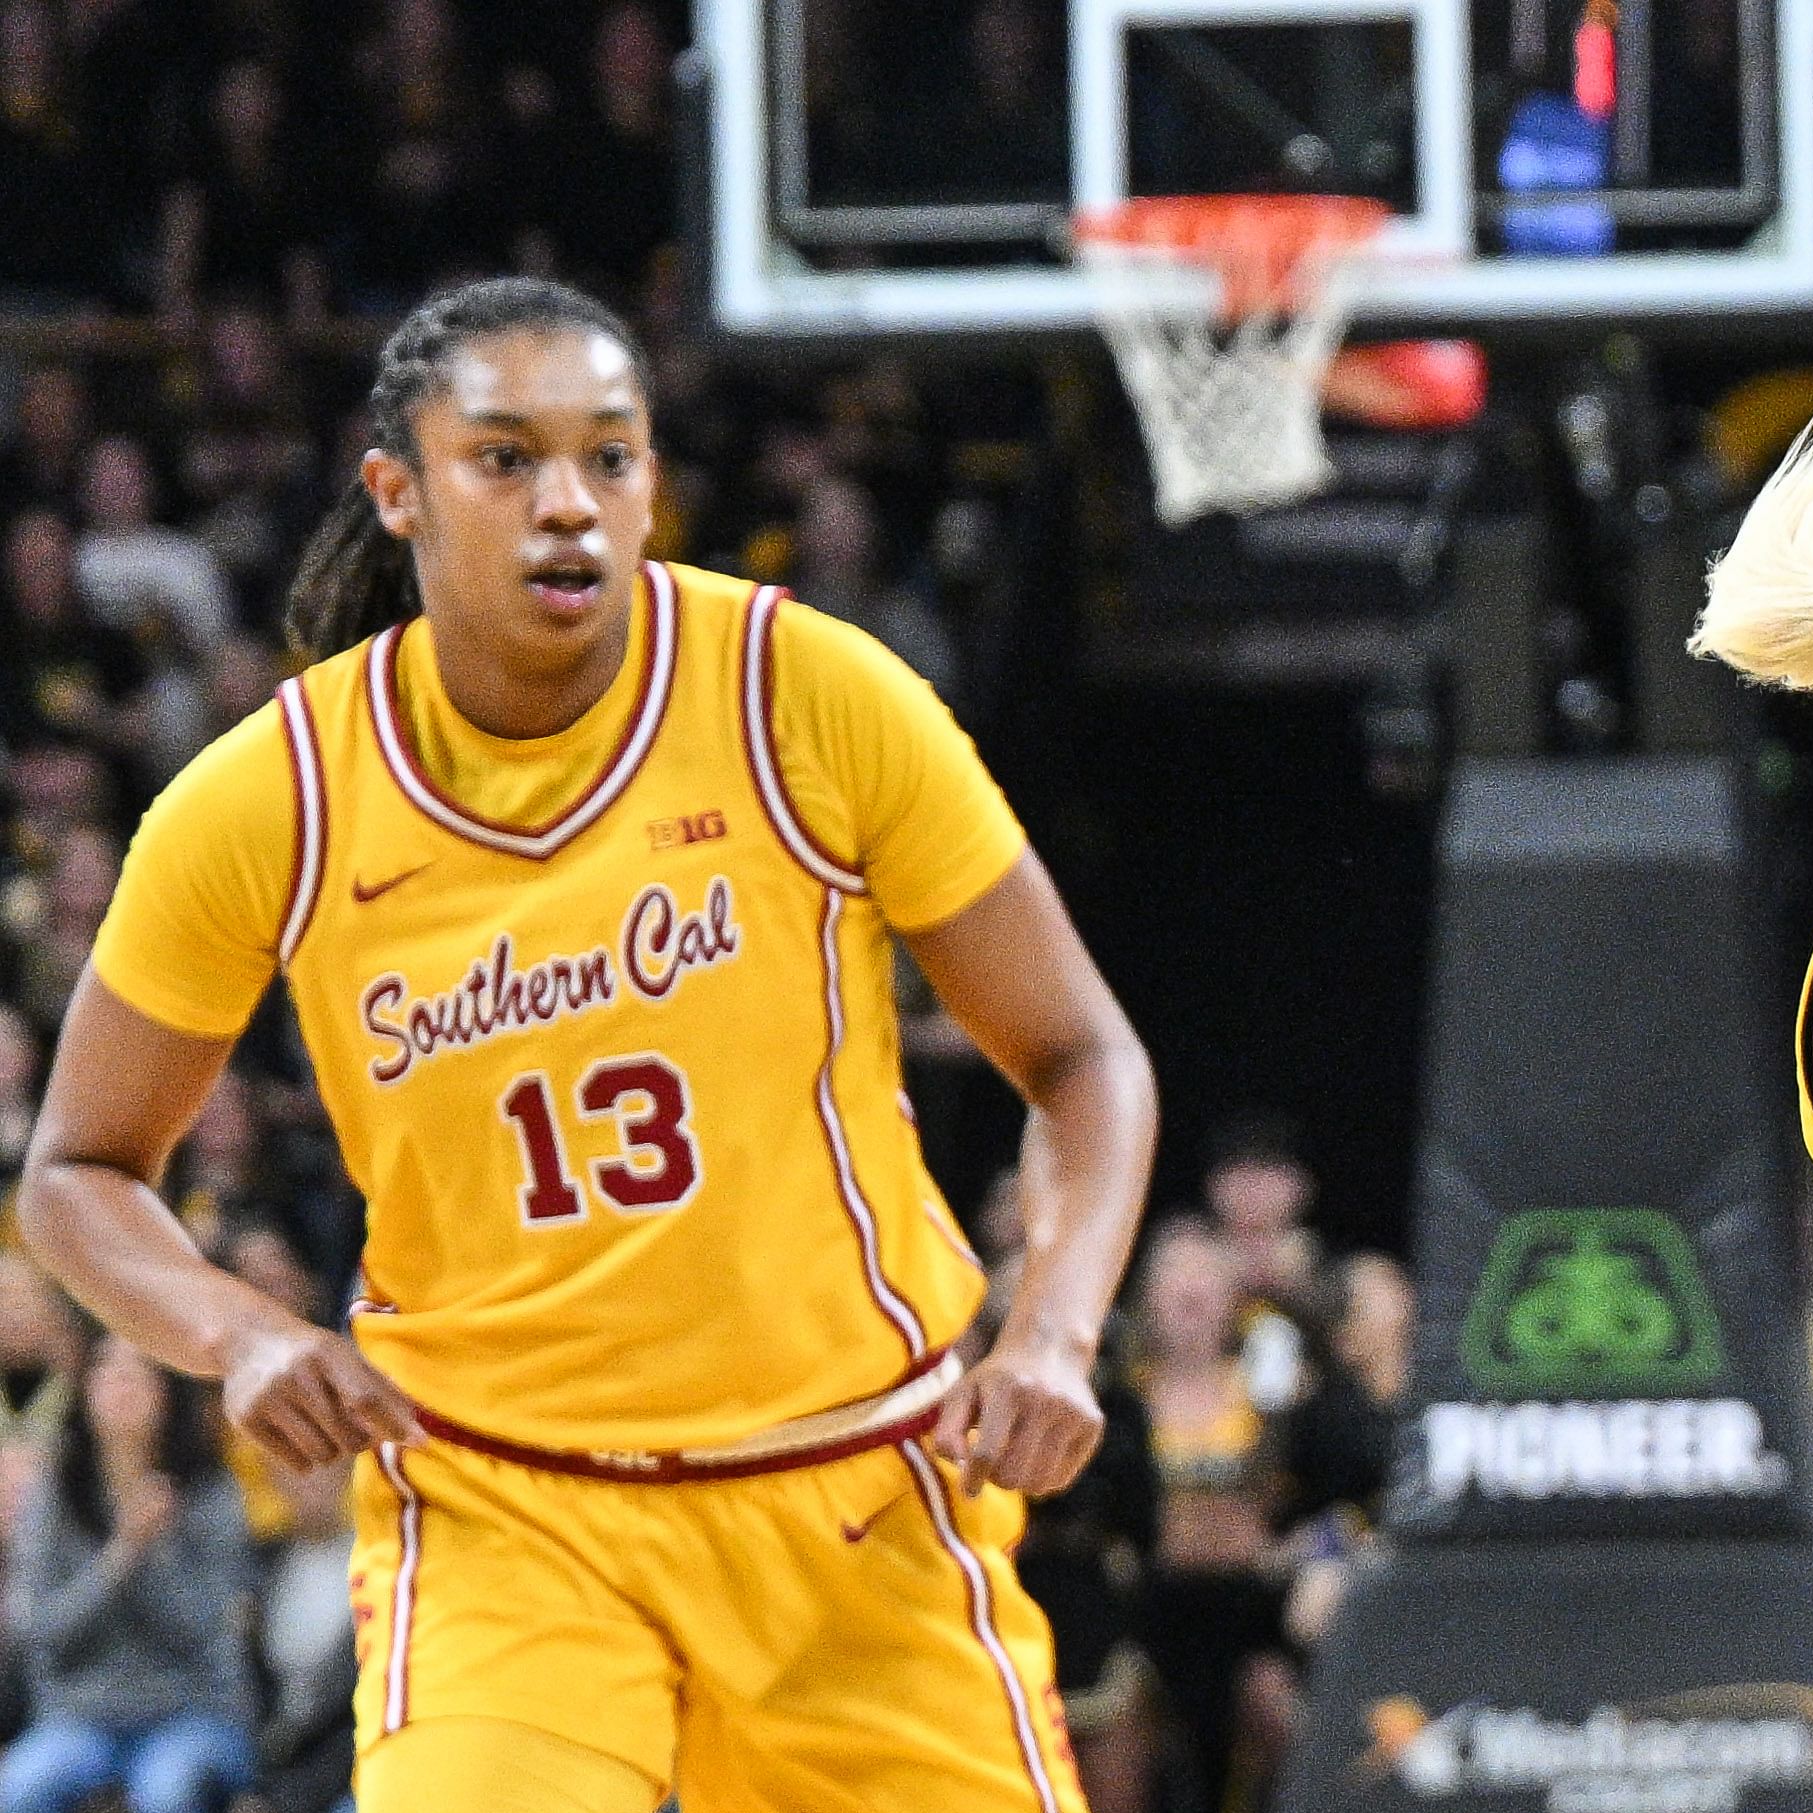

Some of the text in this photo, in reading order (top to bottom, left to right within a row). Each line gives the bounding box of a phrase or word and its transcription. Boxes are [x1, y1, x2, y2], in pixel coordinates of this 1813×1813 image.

[360, 874, 741, 1086] Southern Cal
[502, 1051, 702, 1226] 13
